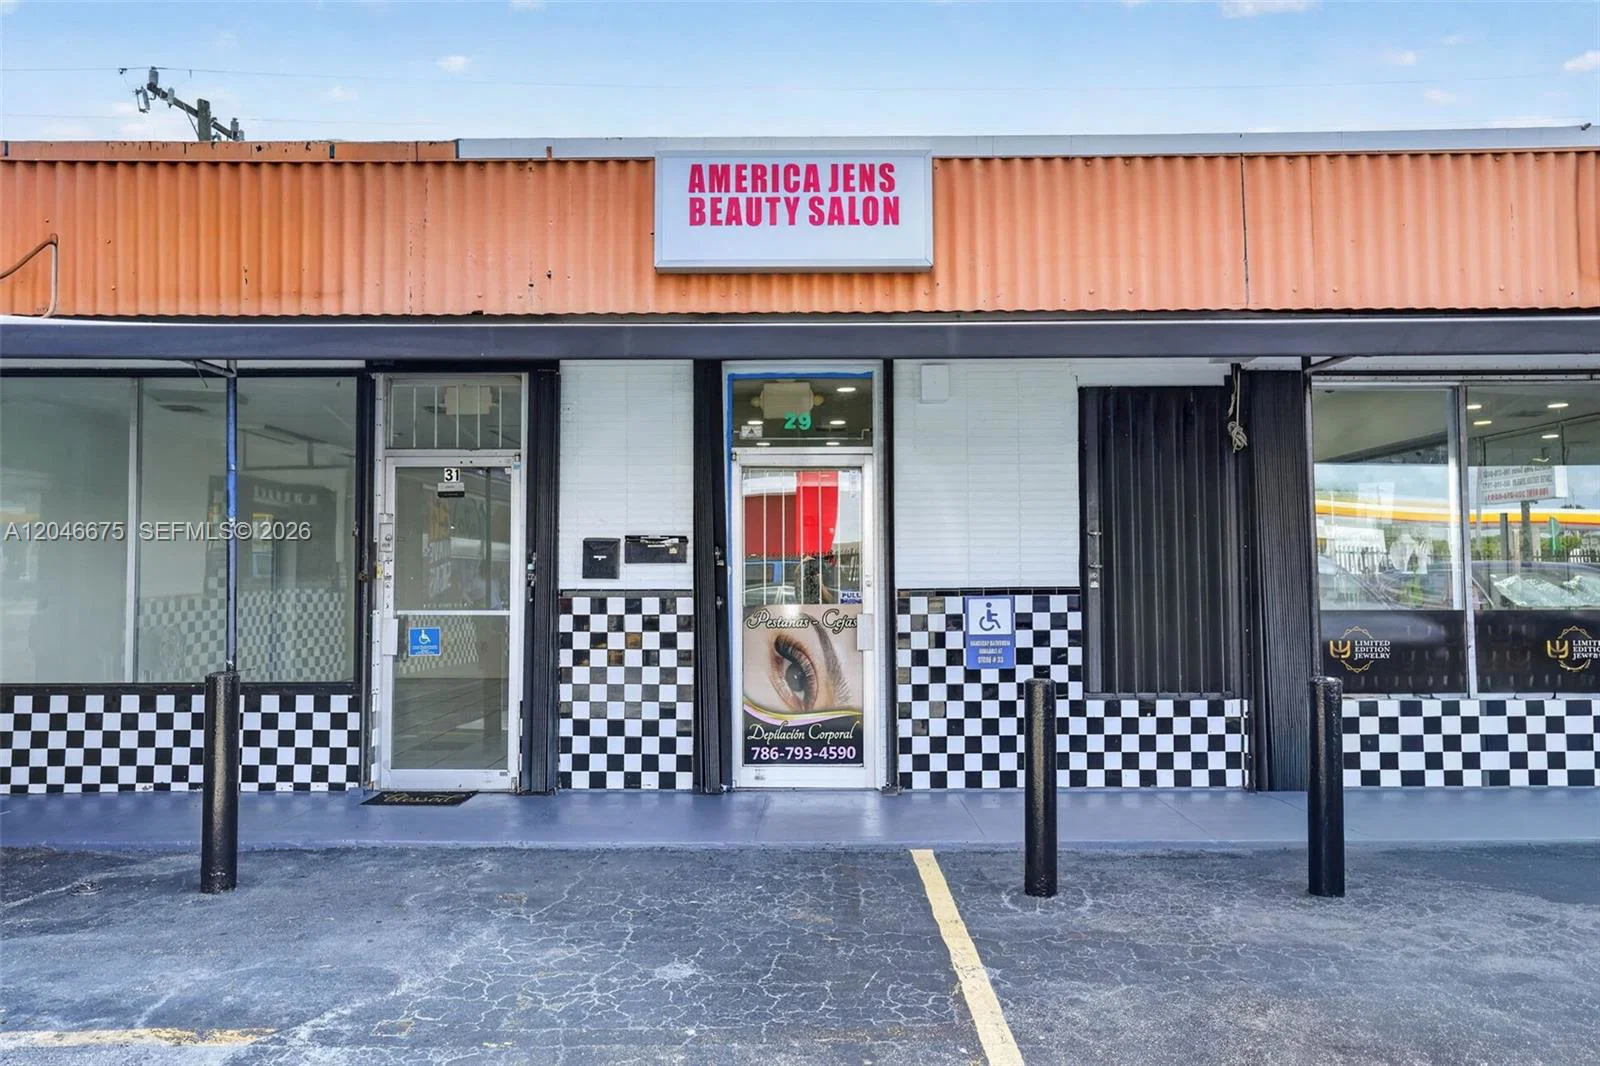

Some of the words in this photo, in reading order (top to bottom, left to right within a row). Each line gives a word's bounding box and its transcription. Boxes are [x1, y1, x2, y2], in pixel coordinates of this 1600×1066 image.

[688, 163, 820, 193] AMERICA
[829, 163, 896, 193] JENS
[689, 196, 800, 226] BEAUTY
[808, 196, 900, 226] SALON
[784, 411, 811, 430] 29
[445, 469, 459, 481] 31
[822, 608, 858, 635] Cejas
[1354, 652, 1391, 660] JEWELRY
[747, 720, 805, 745] Depilación
[808, 720, 860, 745] Corporal
[751, 746, 857, 760] 786-793-4590
